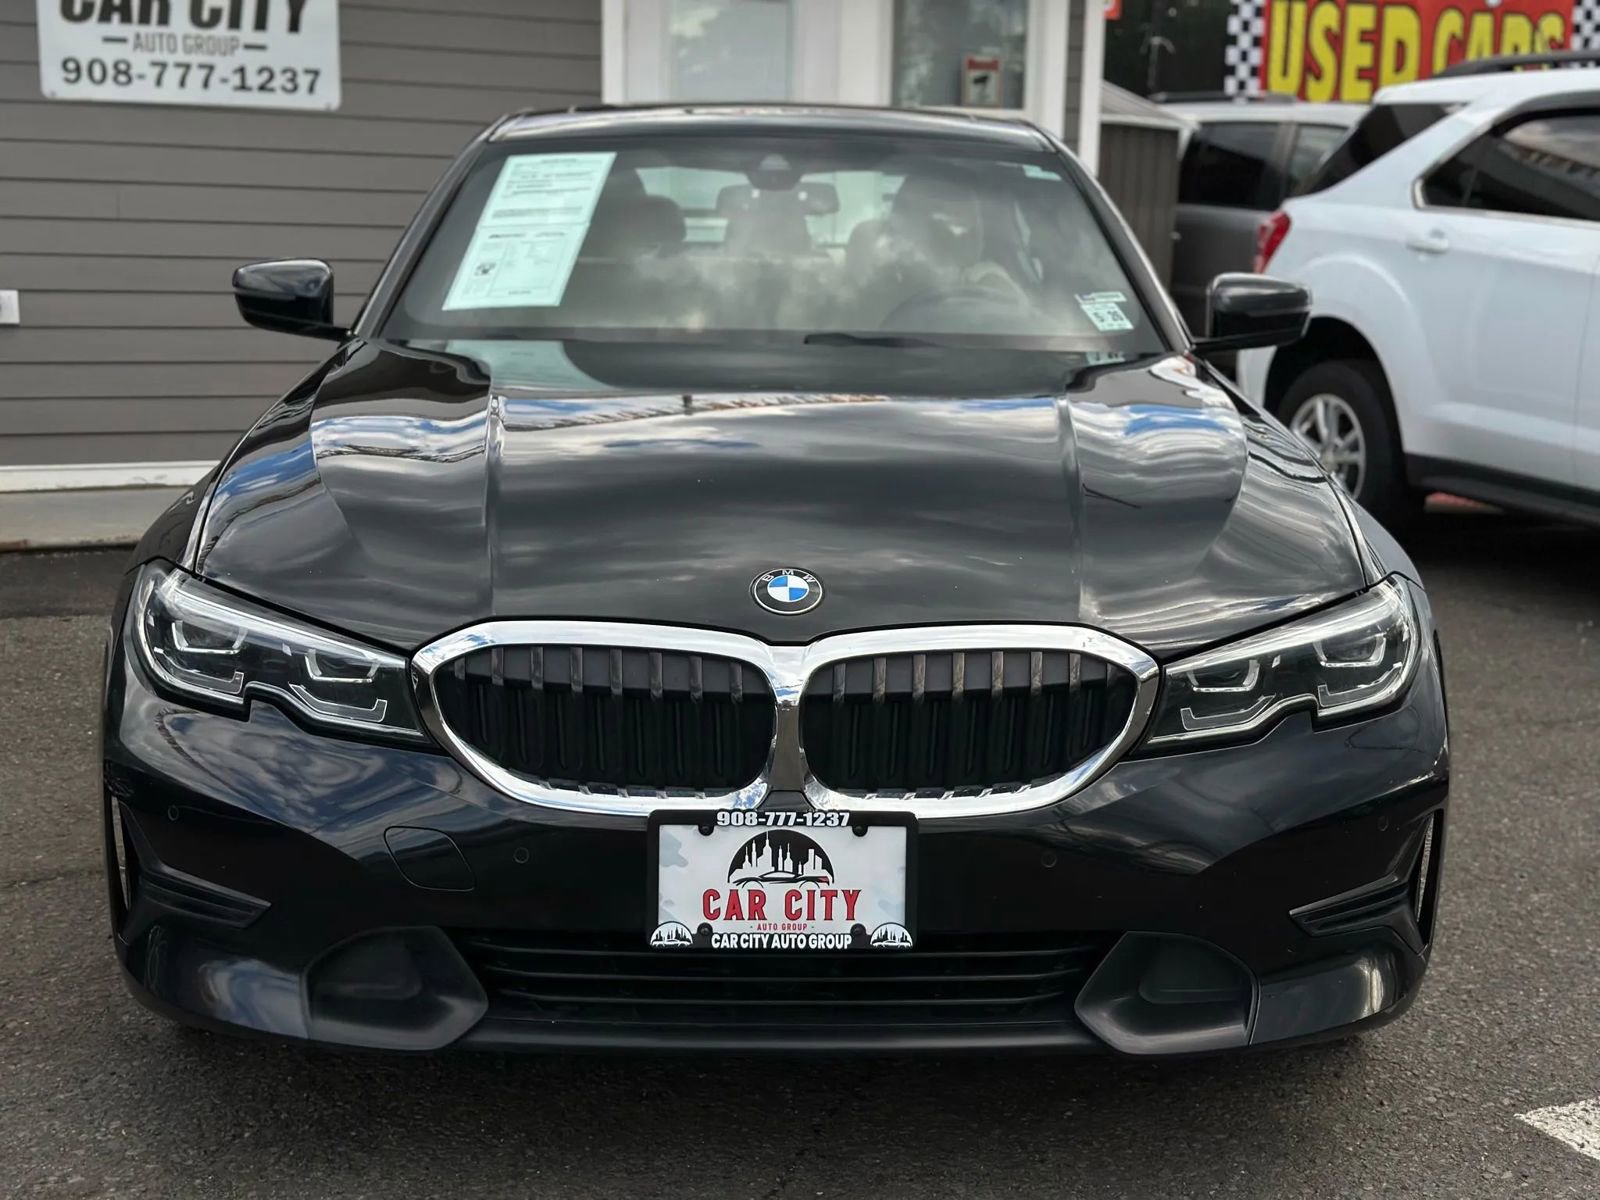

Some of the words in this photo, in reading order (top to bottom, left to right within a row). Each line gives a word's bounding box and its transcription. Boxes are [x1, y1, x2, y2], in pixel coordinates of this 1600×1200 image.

[133, 32, 178, 54] AUTO
[182, 34, 241, 57] GROUP
[1268, 0, 1420, 103] USED
[61, 57, 322, 95] 908-777-1237
[716, 811, 850, 827] 908-777-1237
[702, 889, 767, 921] CAR
[784, 889, 862, 921] CITY
[756, 923, 778, 931] AUTO
[781, 923, 808, 931] GROUP
[711, 933, 738, 949] CAR
[740, 933, 770, 949] CITY
[771, 933, 807, 949] AUTO
[808, 934, 852, 950] GROUP
